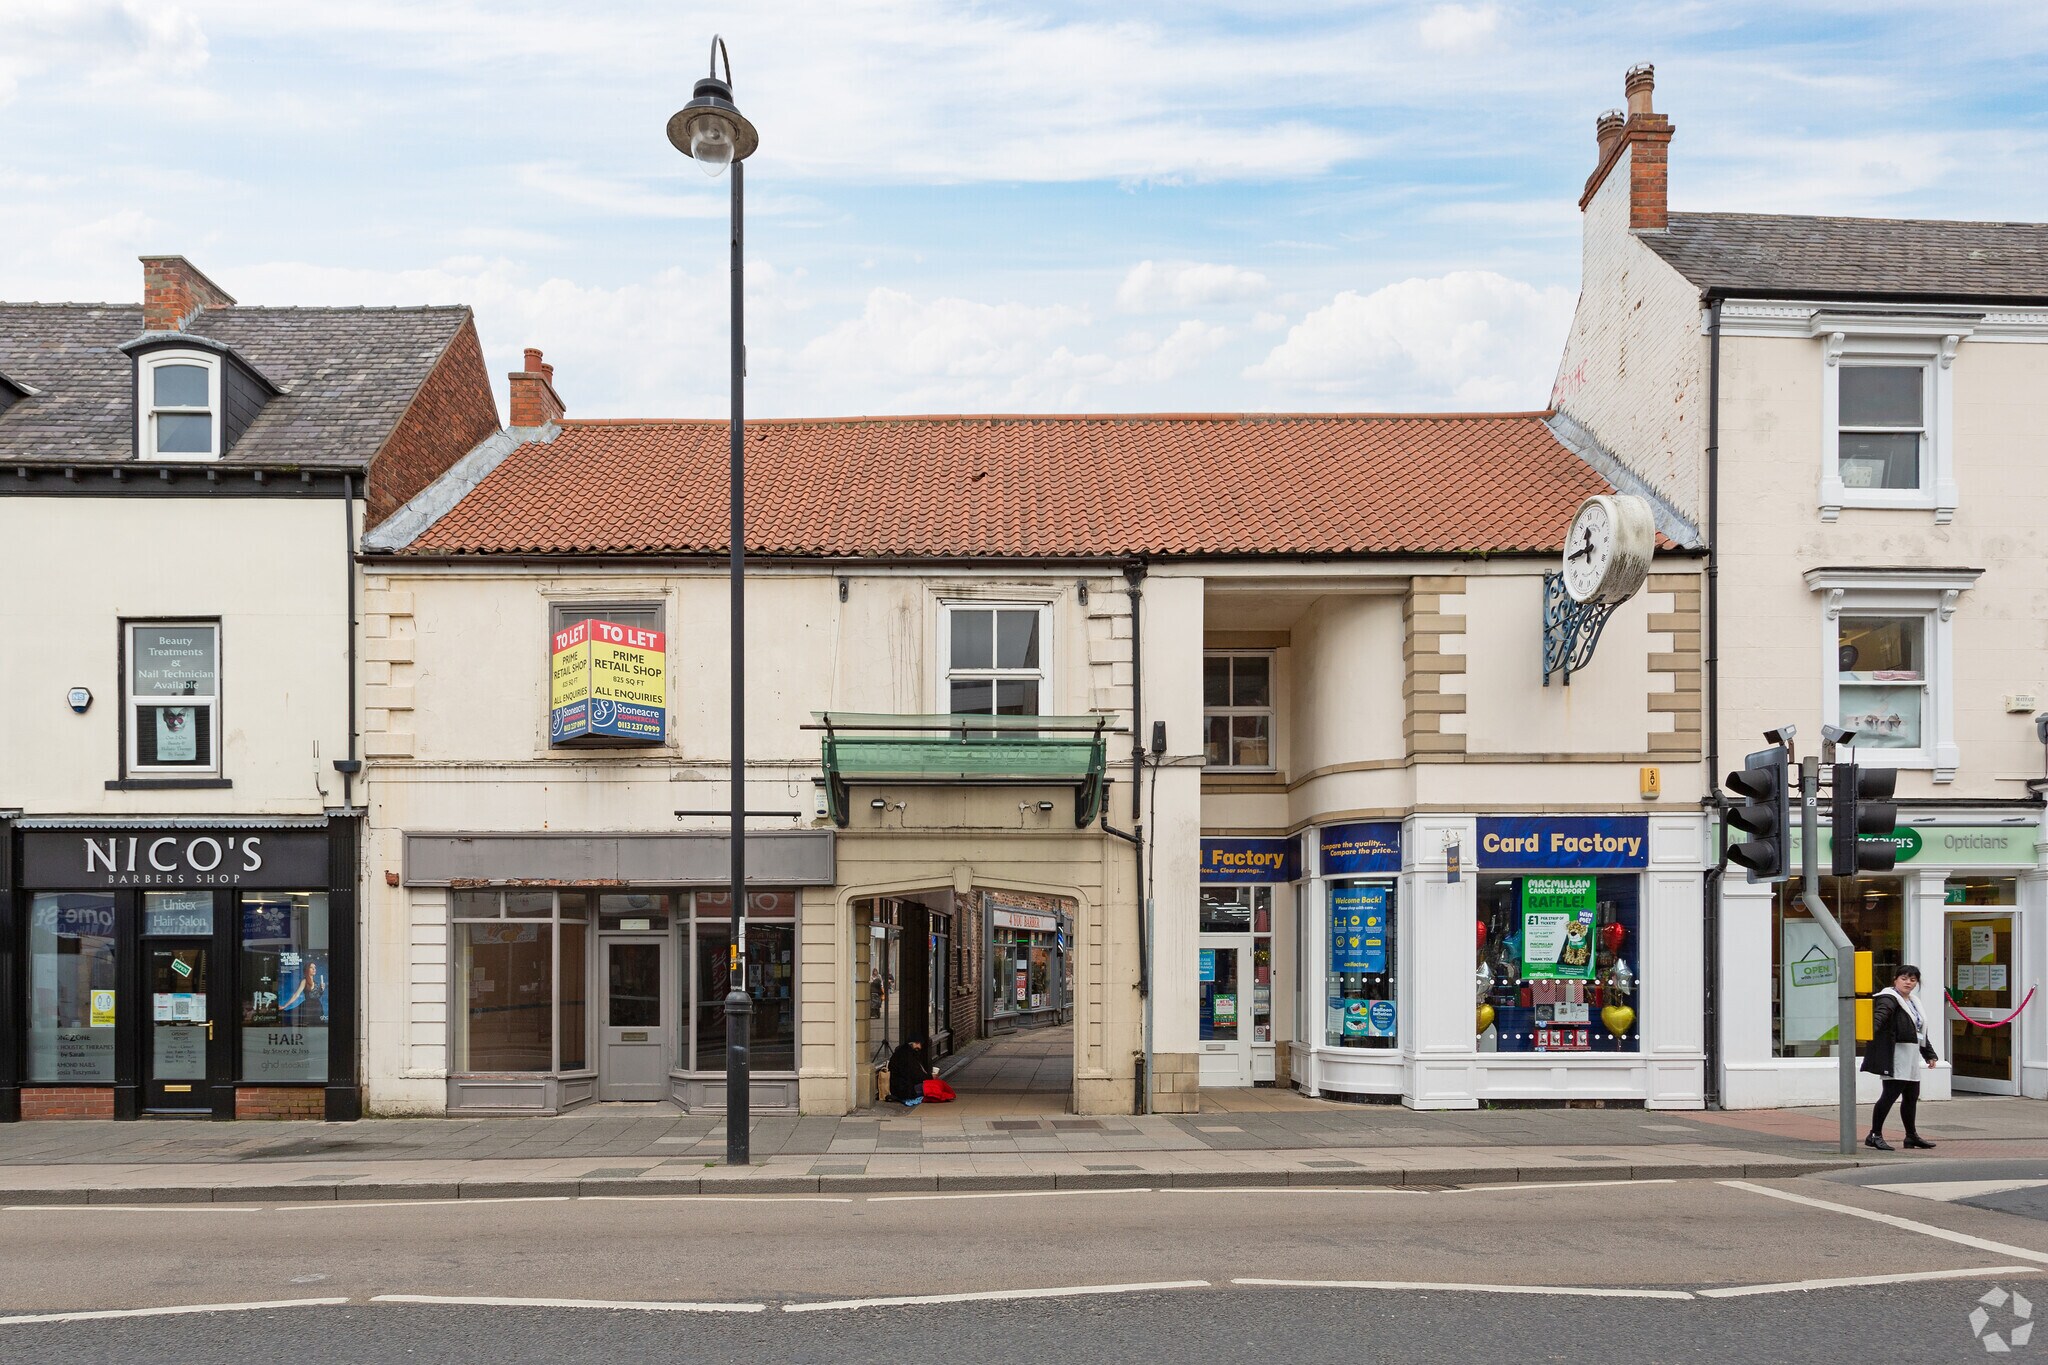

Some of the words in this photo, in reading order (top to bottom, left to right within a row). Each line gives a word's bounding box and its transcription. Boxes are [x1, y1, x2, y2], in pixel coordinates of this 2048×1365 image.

[159, 637, 192, 646] Beauty
[556, 632, 568, 650] TO
[570, 624, 584, 645] LET
[600, 624, 623, 642] TO
[628, 629, 657, 648] LET
[148, 647, 203, 656] Treatments
[613, 650, 644, 664] PRIME
[562, 652, 578, 665] PRIME
[138, 670, 159, 678] Nail
[162, 670, 214, 678] Technician
[554, 665, 571, 680] RETAIL
[572, 660, 587, 672] SHOP
[595, 658, 630, 673] RETAIL
[634, 665, 662, 678] SHOP
[154, 681, 199, 689] Available
[563, 687, 587, 702] ENQUIRIES
[595, 686, 611, 696] ALL
[614, 688, 662, 703] ENQUIRIES
[564, 704, 585, 717] Stoneacre
[617, 703, 659, 718] Stoneacre
[618, 714, 659, 724] COMMERCIAL
[644, 725, 660, 733] 0999
[1355, 840, 1386, 848] quality...
[1483, 833, 1539, 852] Card
[1551, 833, 1642, 857] Factory
[1945, 834, 2008, 851] Opticians
[84, 837, 262, 872] NICO'S
[1212, 850, 1284, 869] Factory
[108, 875, 184, 883] BARBERS
[196, 874, 240, 883] SHOP
[1528, 879, 1590, 888] MACMILLAN
[163, 899, 196, 910] Unisex
[1529, 895, 1585, 908] RAFFLE!
[154, 916, 175, 926] Hair
[179, 915, 206, 926] Salon
[1528, 916, 1538, 925] £1
[175, 962, 188, 973] OPEN
[1804, 966, 1829, 974] OPEN
[268, 1034, 304, 1045] HAIR
[261, 1060, 279, 1072] ghd
